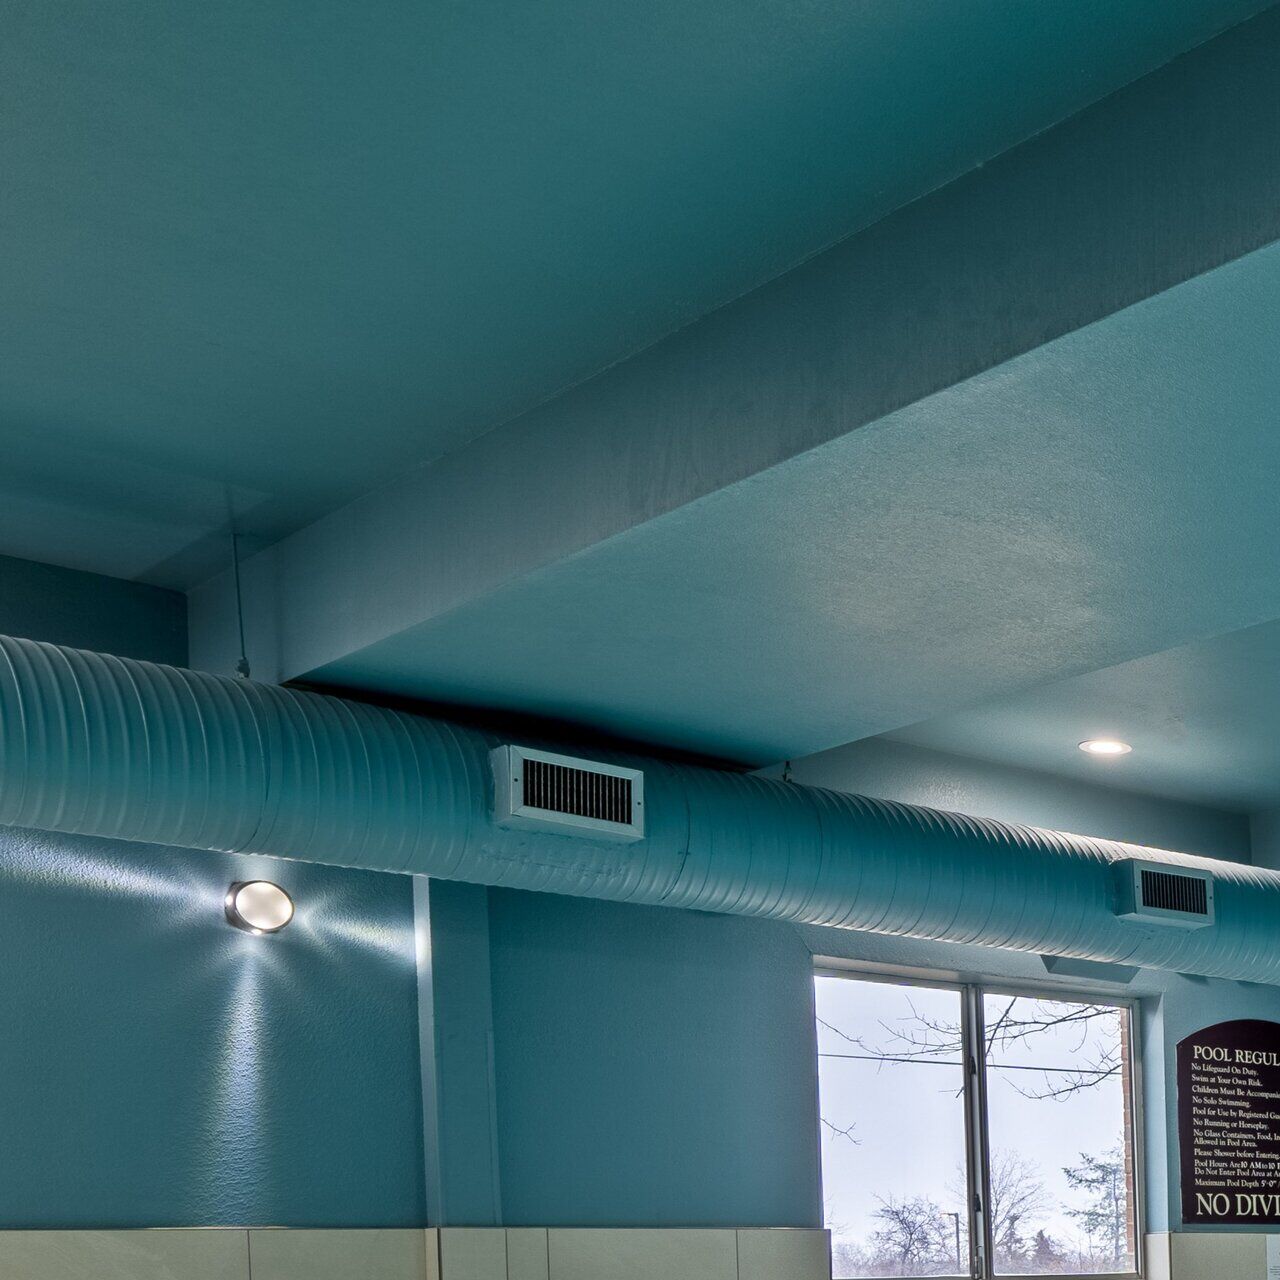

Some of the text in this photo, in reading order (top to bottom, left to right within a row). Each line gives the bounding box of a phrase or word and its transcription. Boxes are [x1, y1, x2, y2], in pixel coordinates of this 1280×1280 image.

[1193, 1045, 1232, 1062] POOL
[1202, 1064, 1230, 1073] Lifeguard
[1231, 1066, 1241, 1074] On
[1192, 1074, 1208, 1082] Swim
[1217, 1076, 1231, 1084] Your
[1192, 1085, 1218, 1094] Children
[1220, 1087, 1235, 1095] Must
[1237, 1088, 1245, 1096] Be
[1192, 1096, 1202, 1104] No
[1203, 1097, 1217, 1105] Solo
[1193, 1107, 1206, 1115] Pool
[1207, 1107, 1216, 1115] for
[1217, 1108, 1229, 1116] Use
[1230, 1109, 1237, 1118] by
[1238, 1110, 1268, 1118] Registered
[1204, 1118, 1230, 1128] Running
[1194, 1137, 1218, 1145] Allowed
[1194, 1148, 1212, 1156] Please
[1214, 1148, 1235, 1157] Shower
[1236, 1150, 1255, 1158] before
[1194, 1159, 1208, 1167] Pool
[1209, 1160, 1228, 1168] Hours
[1195, 1167, 1204, 1175] Do
[1219, 1168, 1236, 1176] Enter
[1195, 1178, 1225, 1187] Maximum
[1227, 1179, 1240, 1187] Pool
[1241, 1180, 1259, 1188] Depth
[1196, 1193, 1230, 1216] NO
